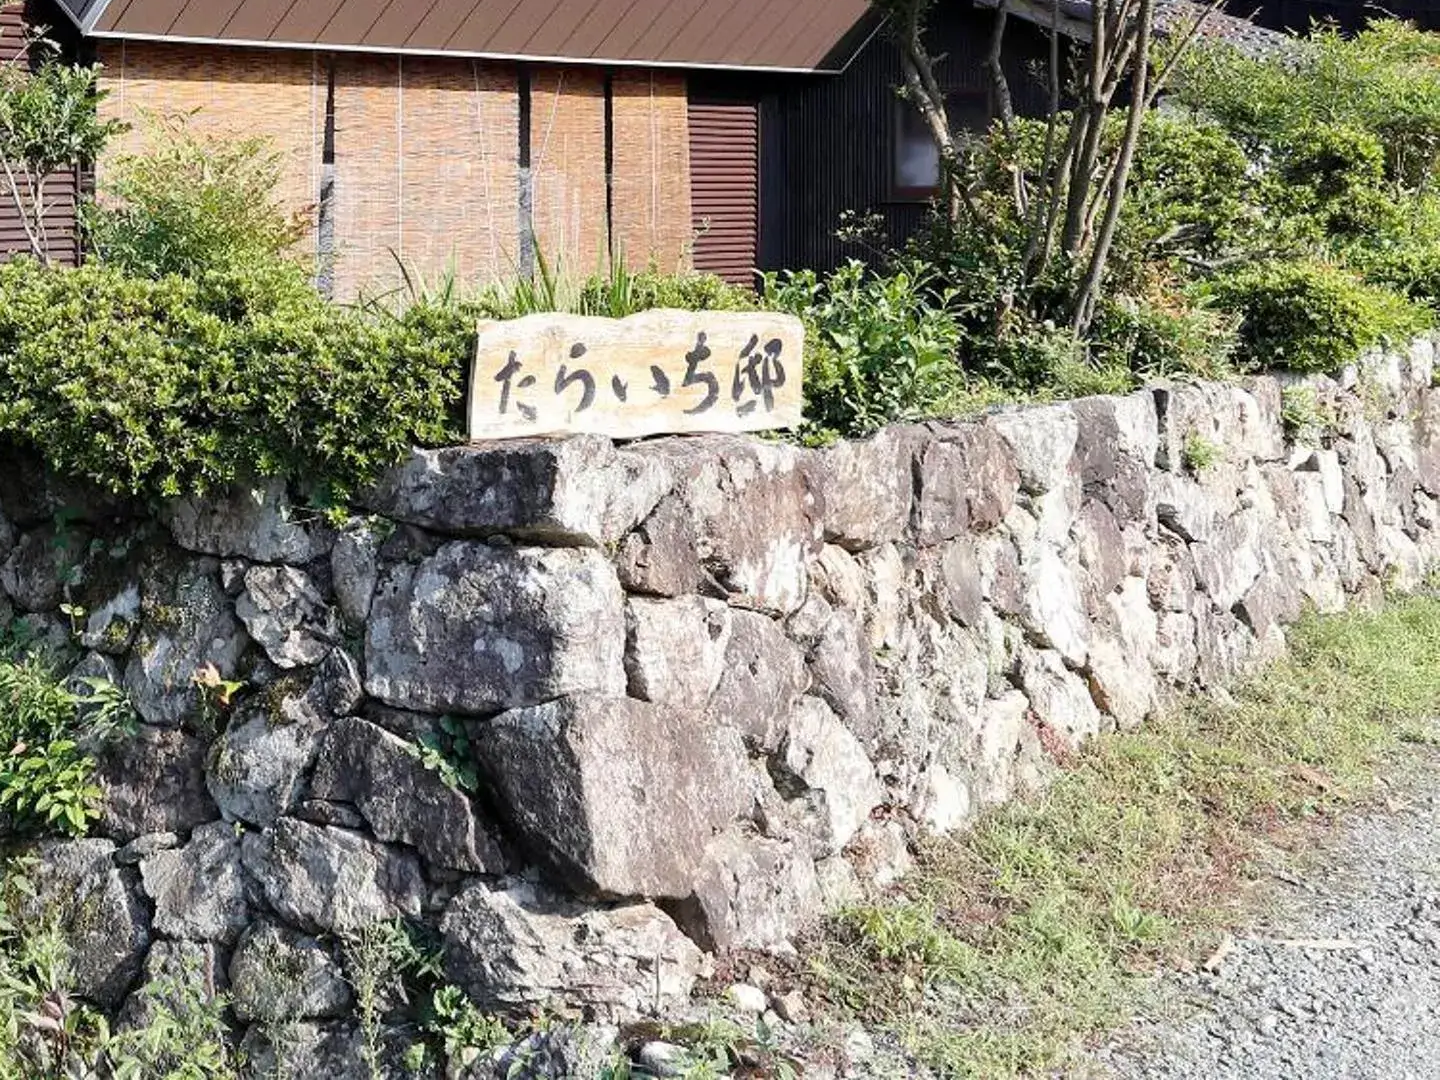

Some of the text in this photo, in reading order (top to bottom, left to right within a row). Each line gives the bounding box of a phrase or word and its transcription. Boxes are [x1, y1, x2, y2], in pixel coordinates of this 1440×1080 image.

[494, 331, 786, 422] たらいち邸
